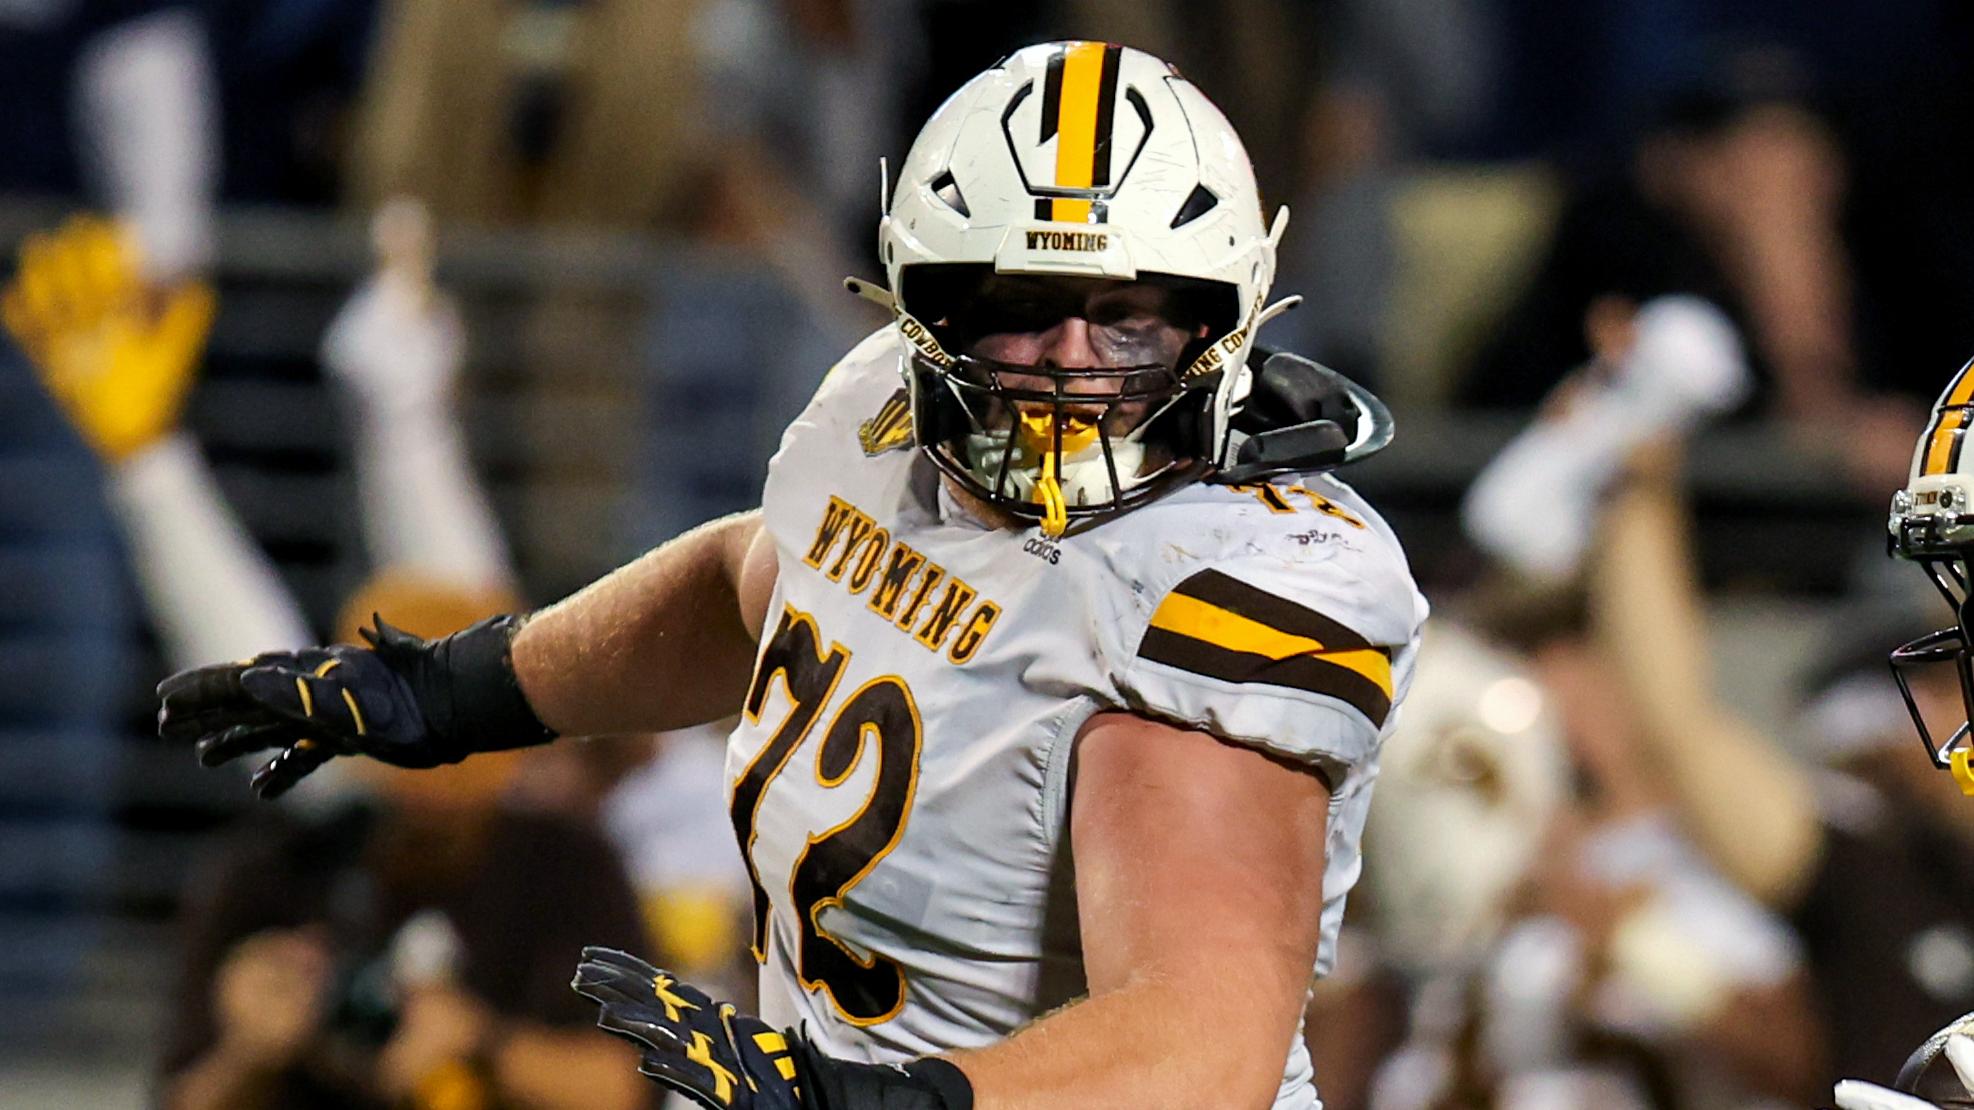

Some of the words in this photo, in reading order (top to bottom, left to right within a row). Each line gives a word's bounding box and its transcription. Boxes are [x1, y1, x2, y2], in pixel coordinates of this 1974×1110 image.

[1025, 231, 1107, 252] WYOMING
[802, 494, 1003, 665] WYOMING
[729, 601, 924, 1026] 72
